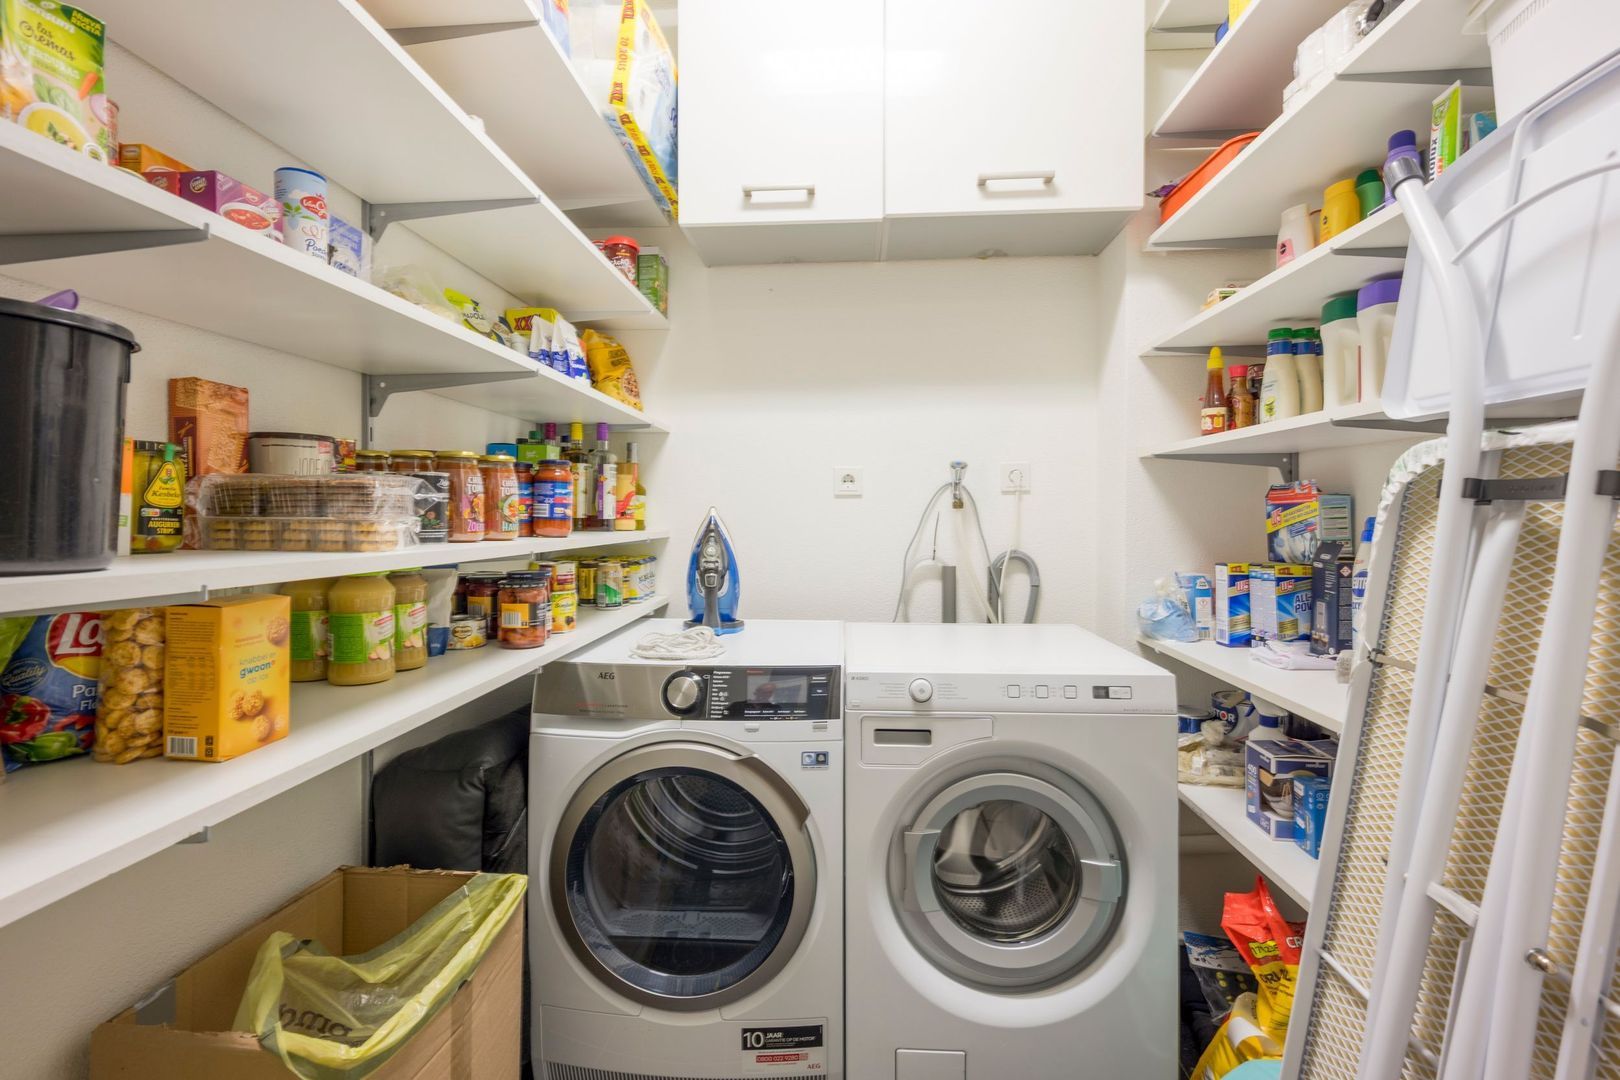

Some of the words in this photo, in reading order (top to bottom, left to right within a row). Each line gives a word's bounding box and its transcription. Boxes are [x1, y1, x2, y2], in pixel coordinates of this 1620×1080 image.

[239, 661, 273, 679] gwoon
[597, 671, 616, 680] AEG
[743, 1031, 764, 1048] 10
